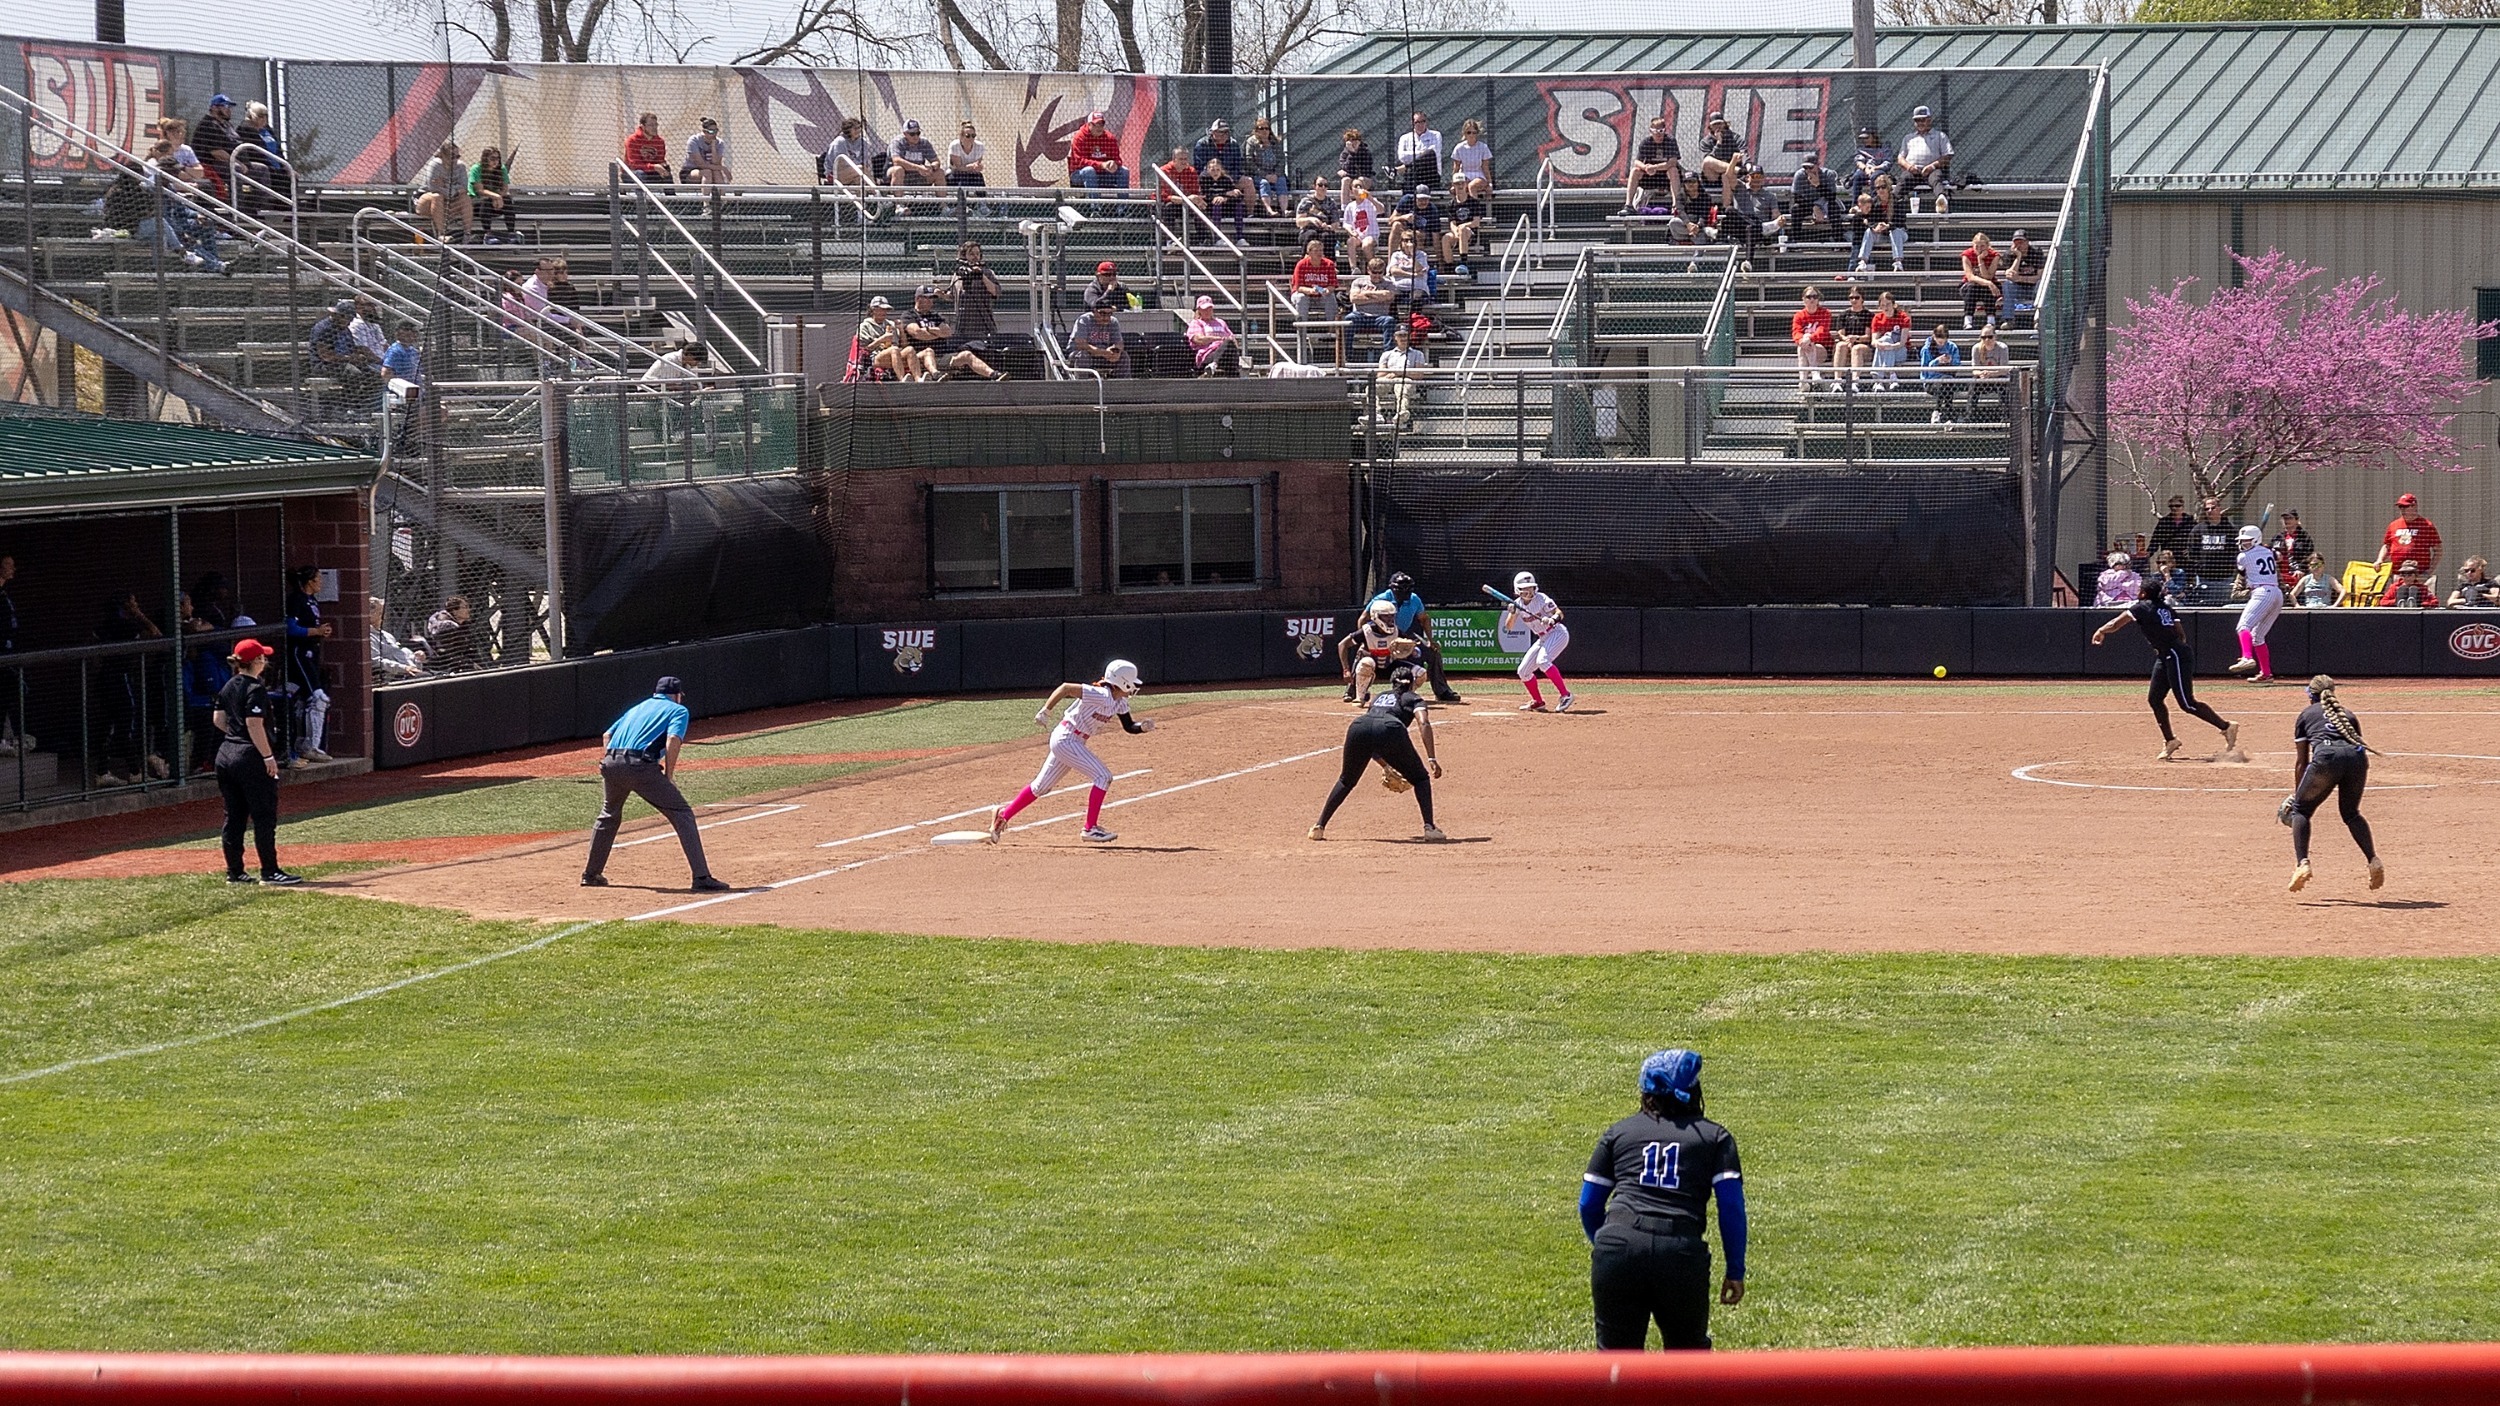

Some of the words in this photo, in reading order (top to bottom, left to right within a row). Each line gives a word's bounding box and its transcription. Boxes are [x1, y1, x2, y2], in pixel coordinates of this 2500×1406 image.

[25, 51, 162, 162] SIUE
[1546, 86, 1822, 178] SIUE
[2256, 556, 2276, 575] 20
[1286, 617, 1334, 636] SIUE
[1431, 618, 1471, 627] NERGY
[882, 630, 934, 649] SIUE
[2461, 634, 2495, 649] OVC
[1442, 656, 1522, 665] REN.COM/REBATE
[400, 715, 416, 735] OVC
[1640, 1142, 1680, 1189] 11
